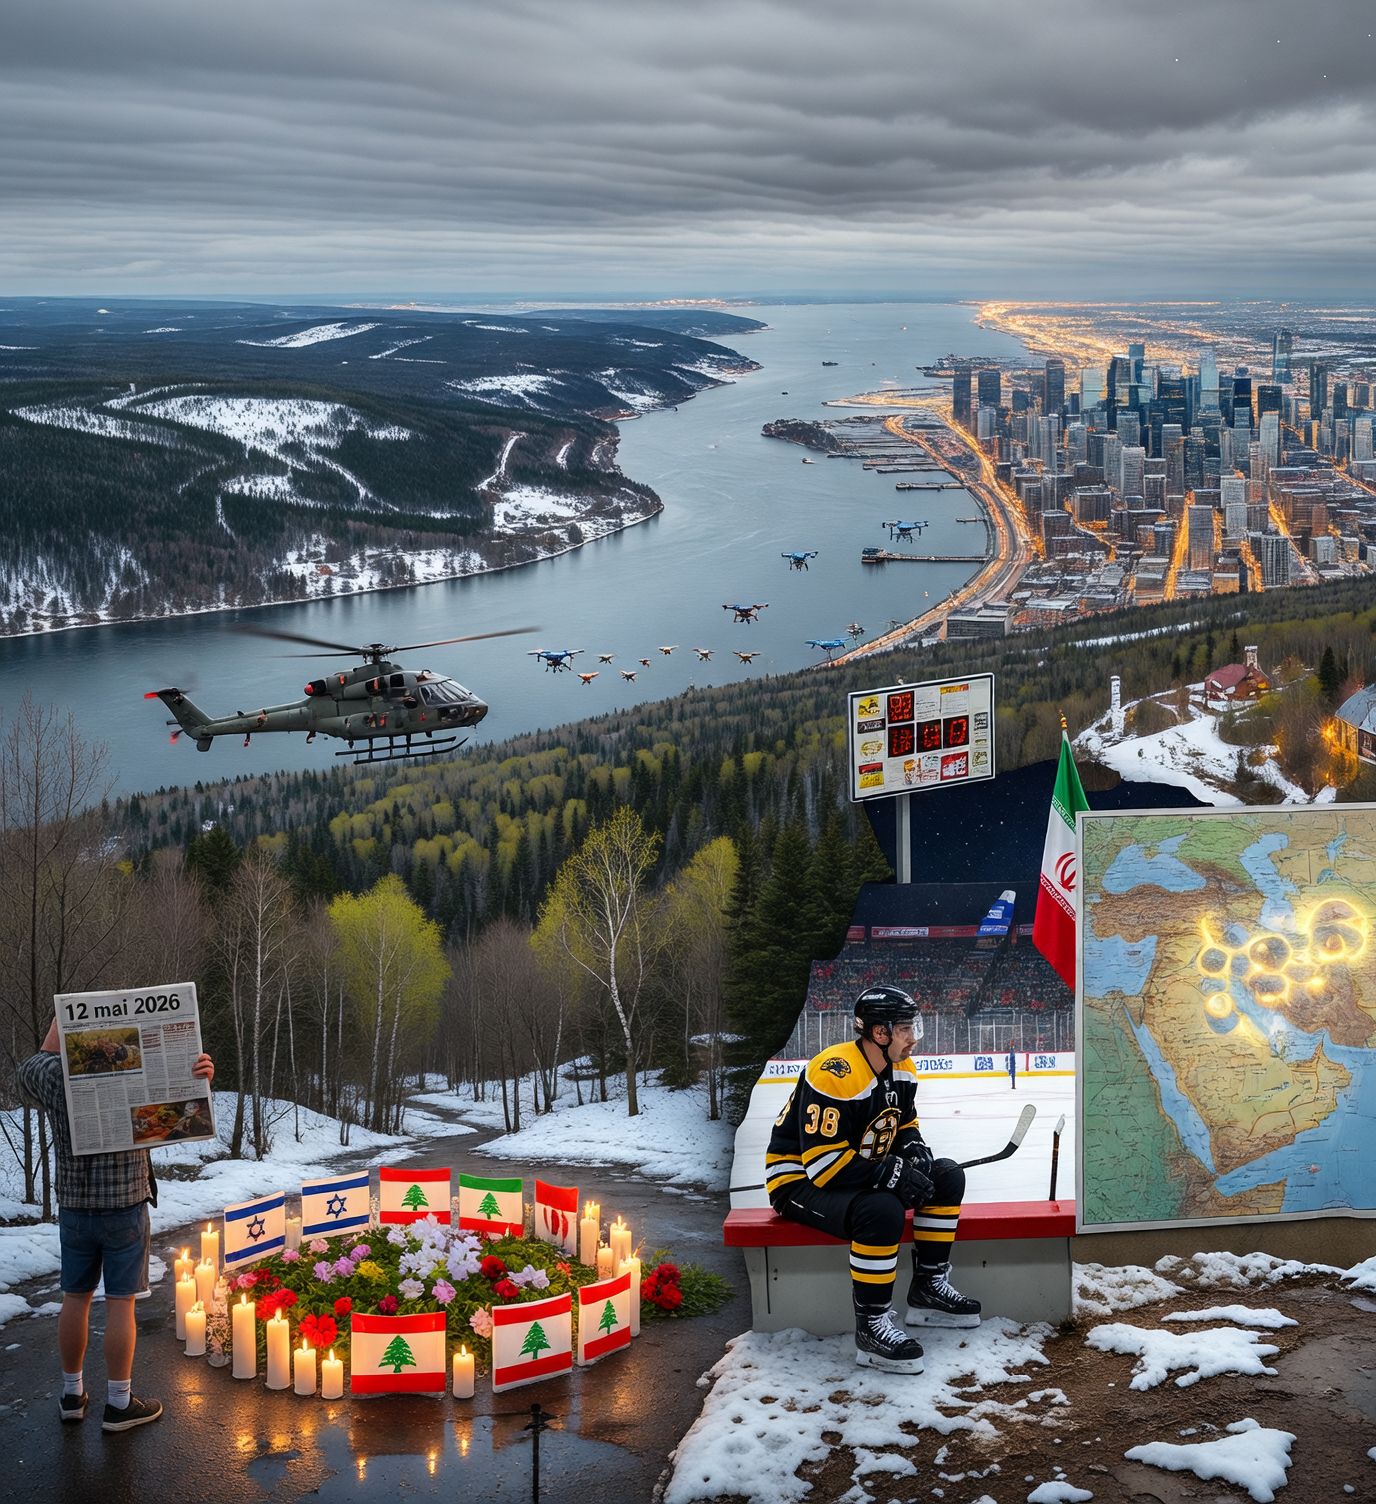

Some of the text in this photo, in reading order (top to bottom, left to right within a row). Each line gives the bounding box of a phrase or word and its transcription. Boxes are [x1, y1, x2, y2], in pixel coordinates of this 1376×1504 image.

[64, 993, 180, 1021] 12 mai 2026
[804, 1103, 841, 1137] 38
